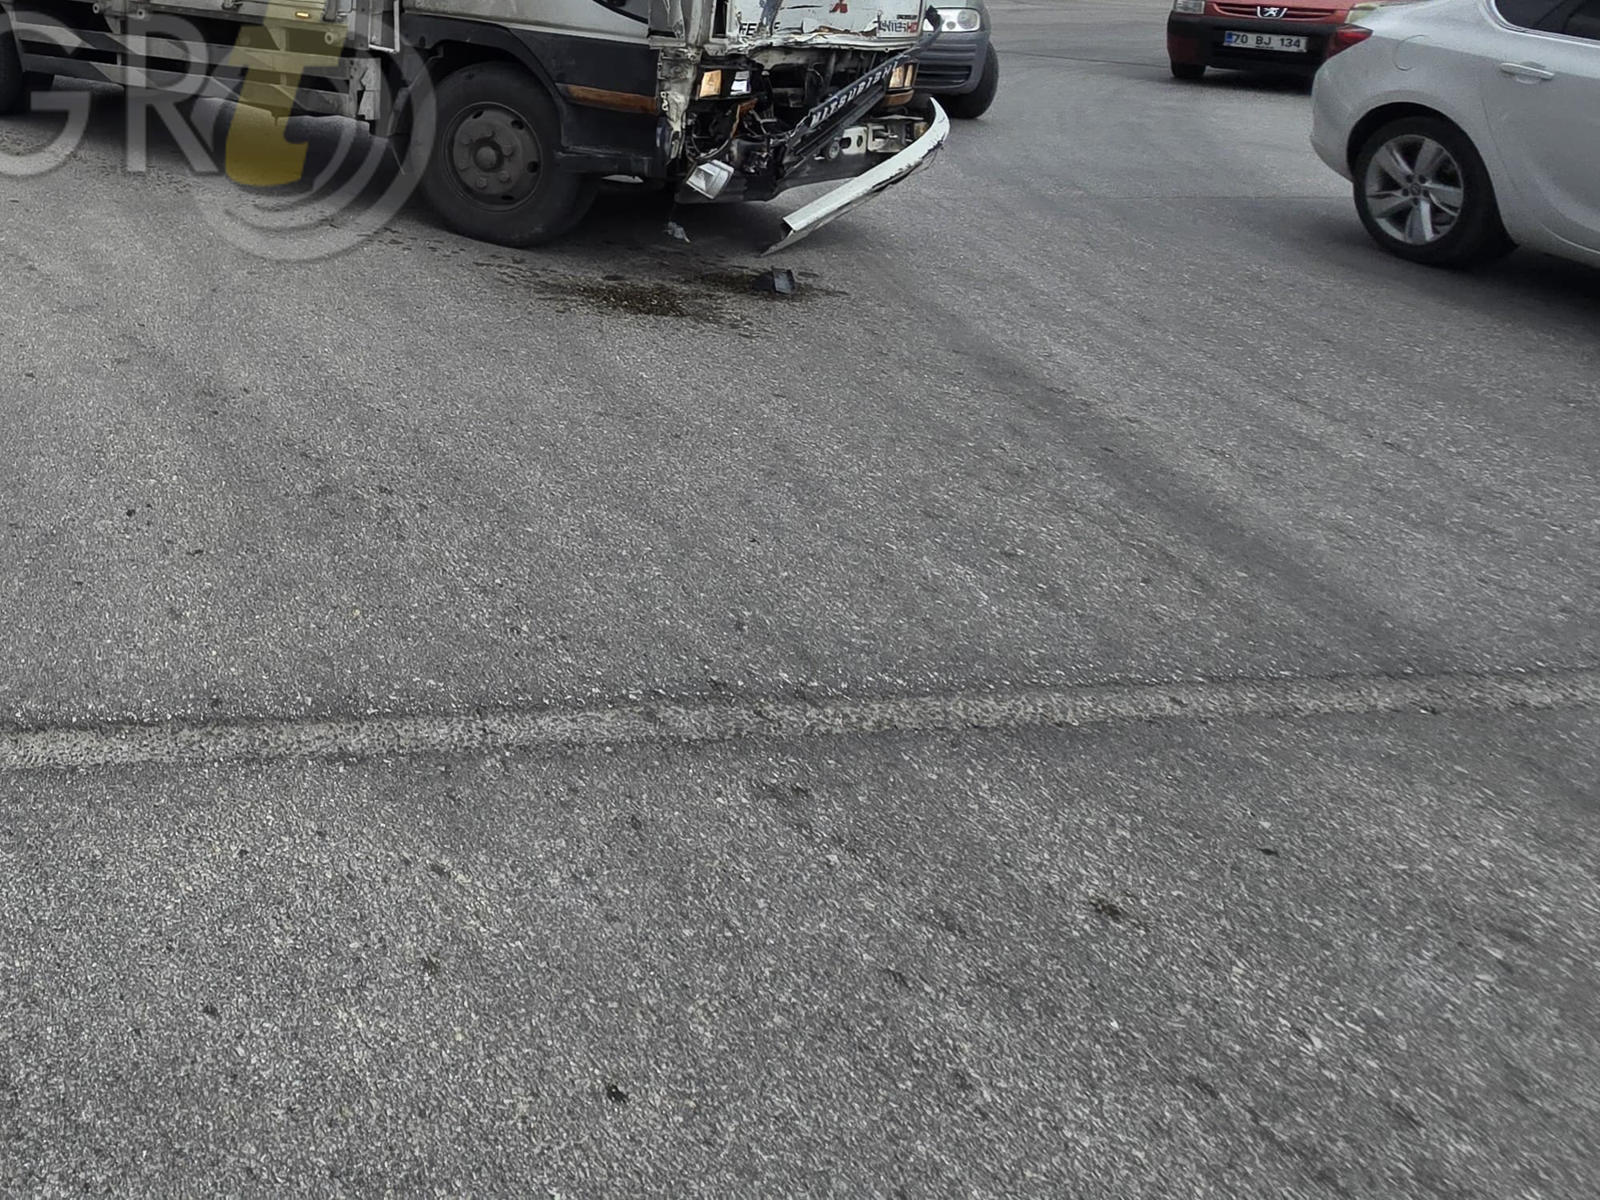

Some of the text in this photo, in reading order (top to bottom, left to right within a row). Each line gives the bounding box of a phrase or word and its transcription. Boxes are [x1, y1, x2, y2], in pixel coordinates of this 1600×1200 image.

[1233, 33, 1301, 49] 70 BJ 134
